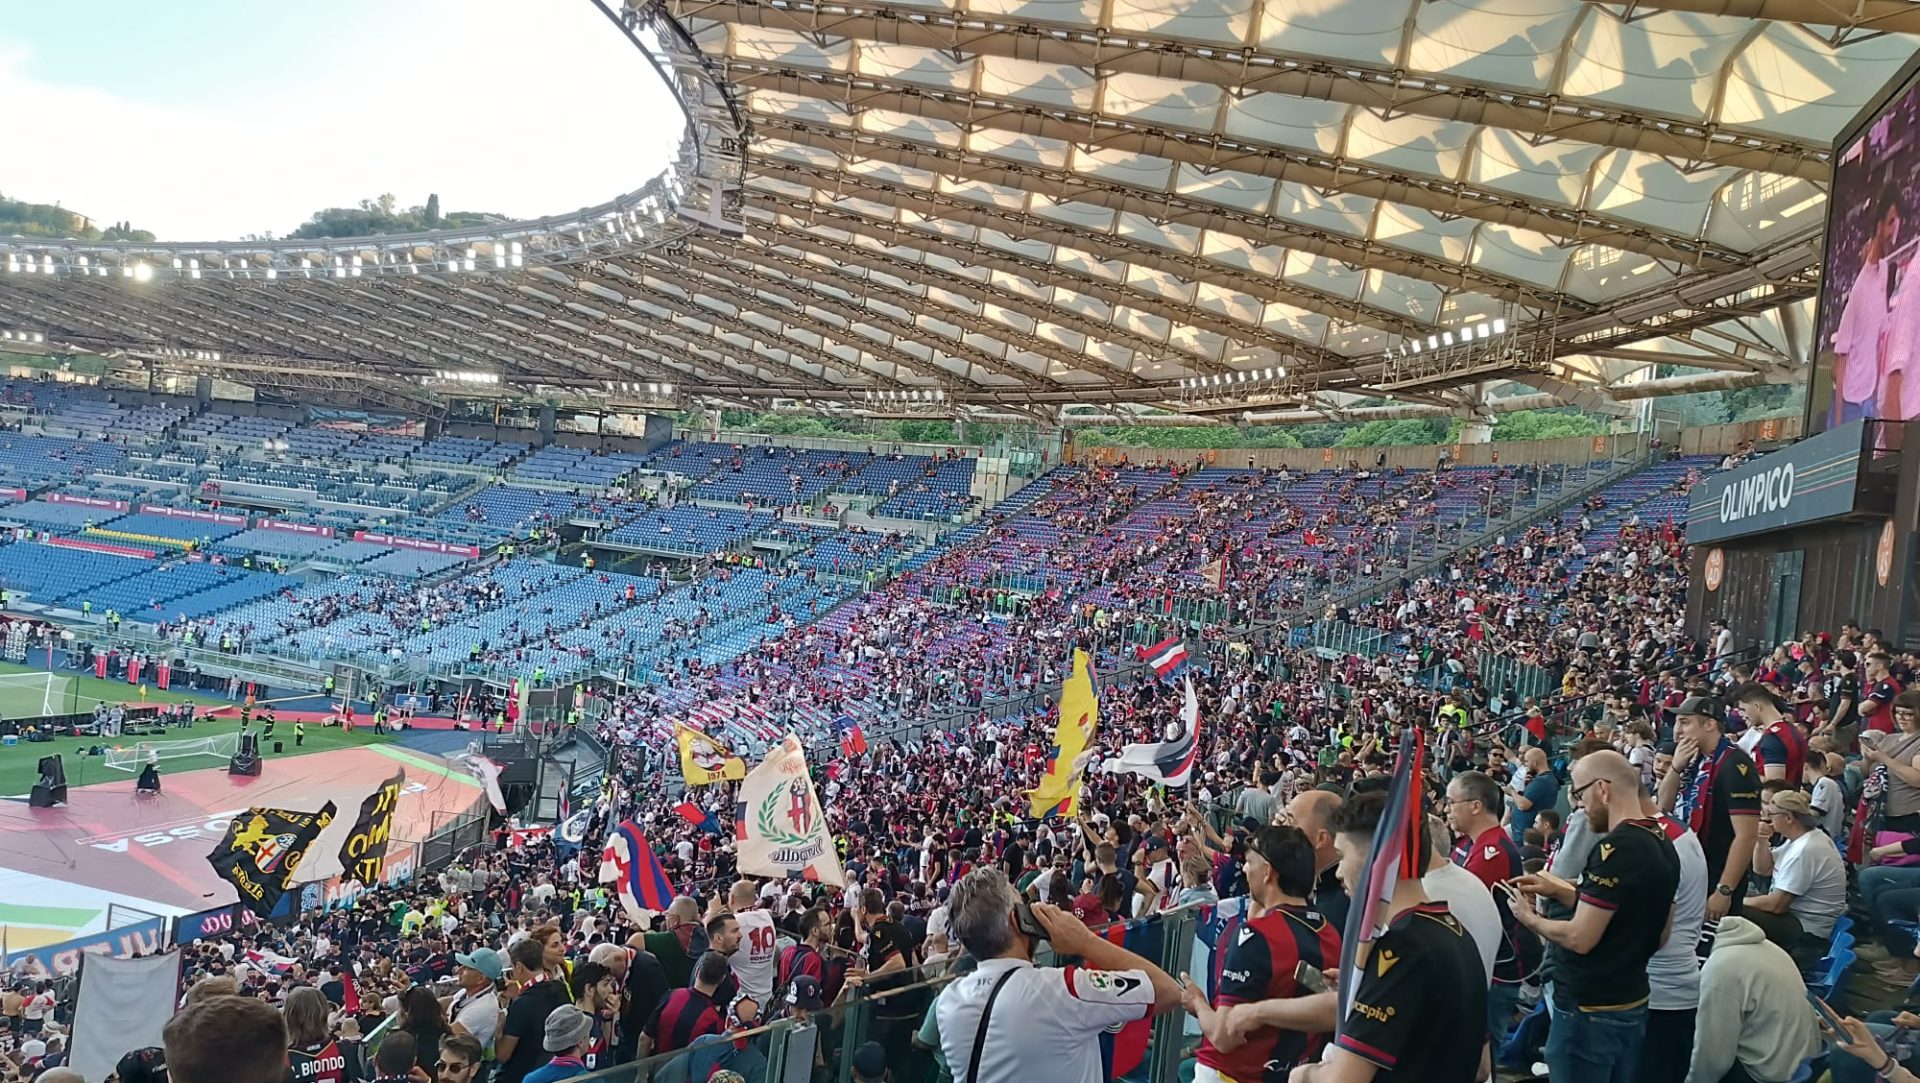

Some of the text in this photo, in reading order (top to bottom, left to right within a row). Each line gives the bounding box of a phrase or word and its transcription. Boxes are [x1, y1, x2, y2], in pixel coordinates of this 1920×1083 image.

[1720, 462, 1795, 523] OLIMPICO
[708, 770, 727, 781] 1974
[748, 926, 775, 956] 10
[976, 978, 993, 986] BFC
[301, 1055, 346, 1077] BIONDO
